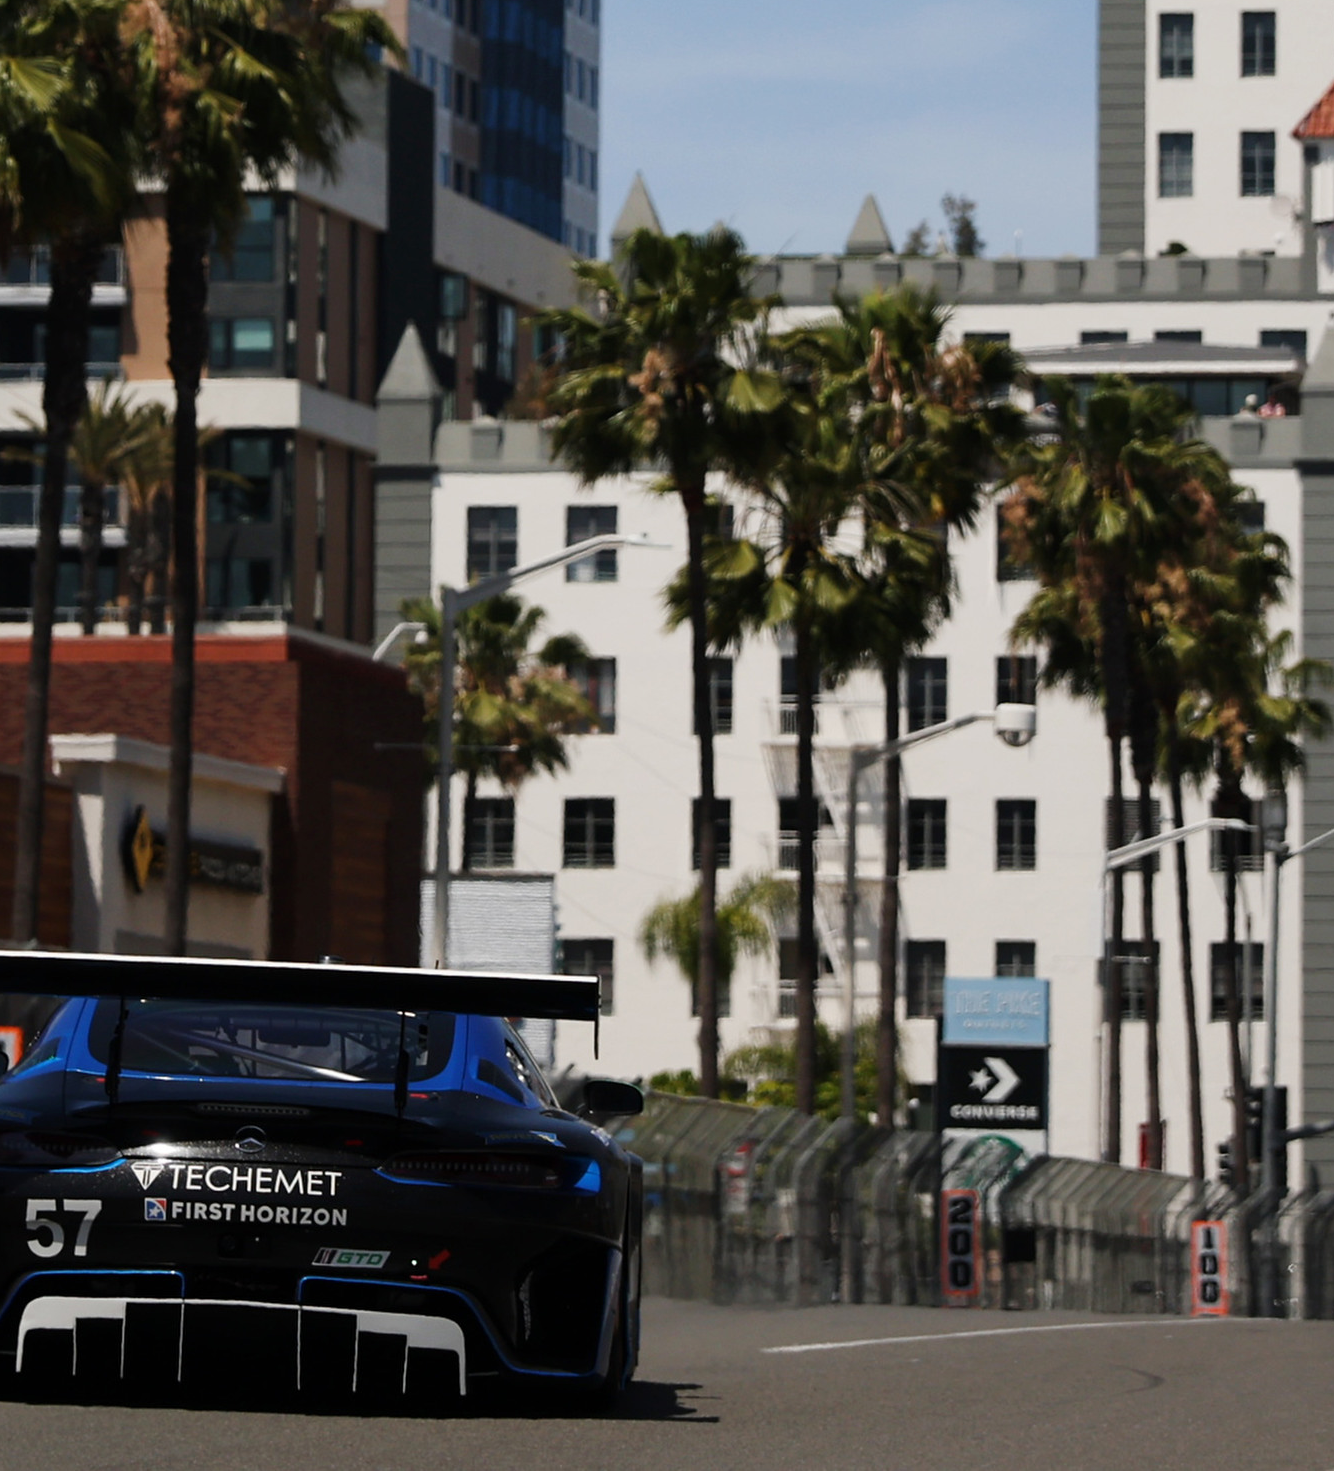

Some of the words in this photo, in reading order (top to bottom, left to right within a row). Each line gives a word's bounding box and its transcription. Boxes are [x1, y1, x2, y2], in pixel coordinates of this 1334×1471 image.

[950, 1104, 1039, 1121] CONVERSE
[169, 1164, 343, 1196] TECHEMET
[26, 1198, 103, 1258] 57
[172, 1201, 236, 1221] FIRST
[239, 1205, 348, 1226] HORIZON
[949, 1196, 973, 1288] 200
[336, 1252, 383, 1265] GTD
[1201, 1227, 1219, 1303] 100
